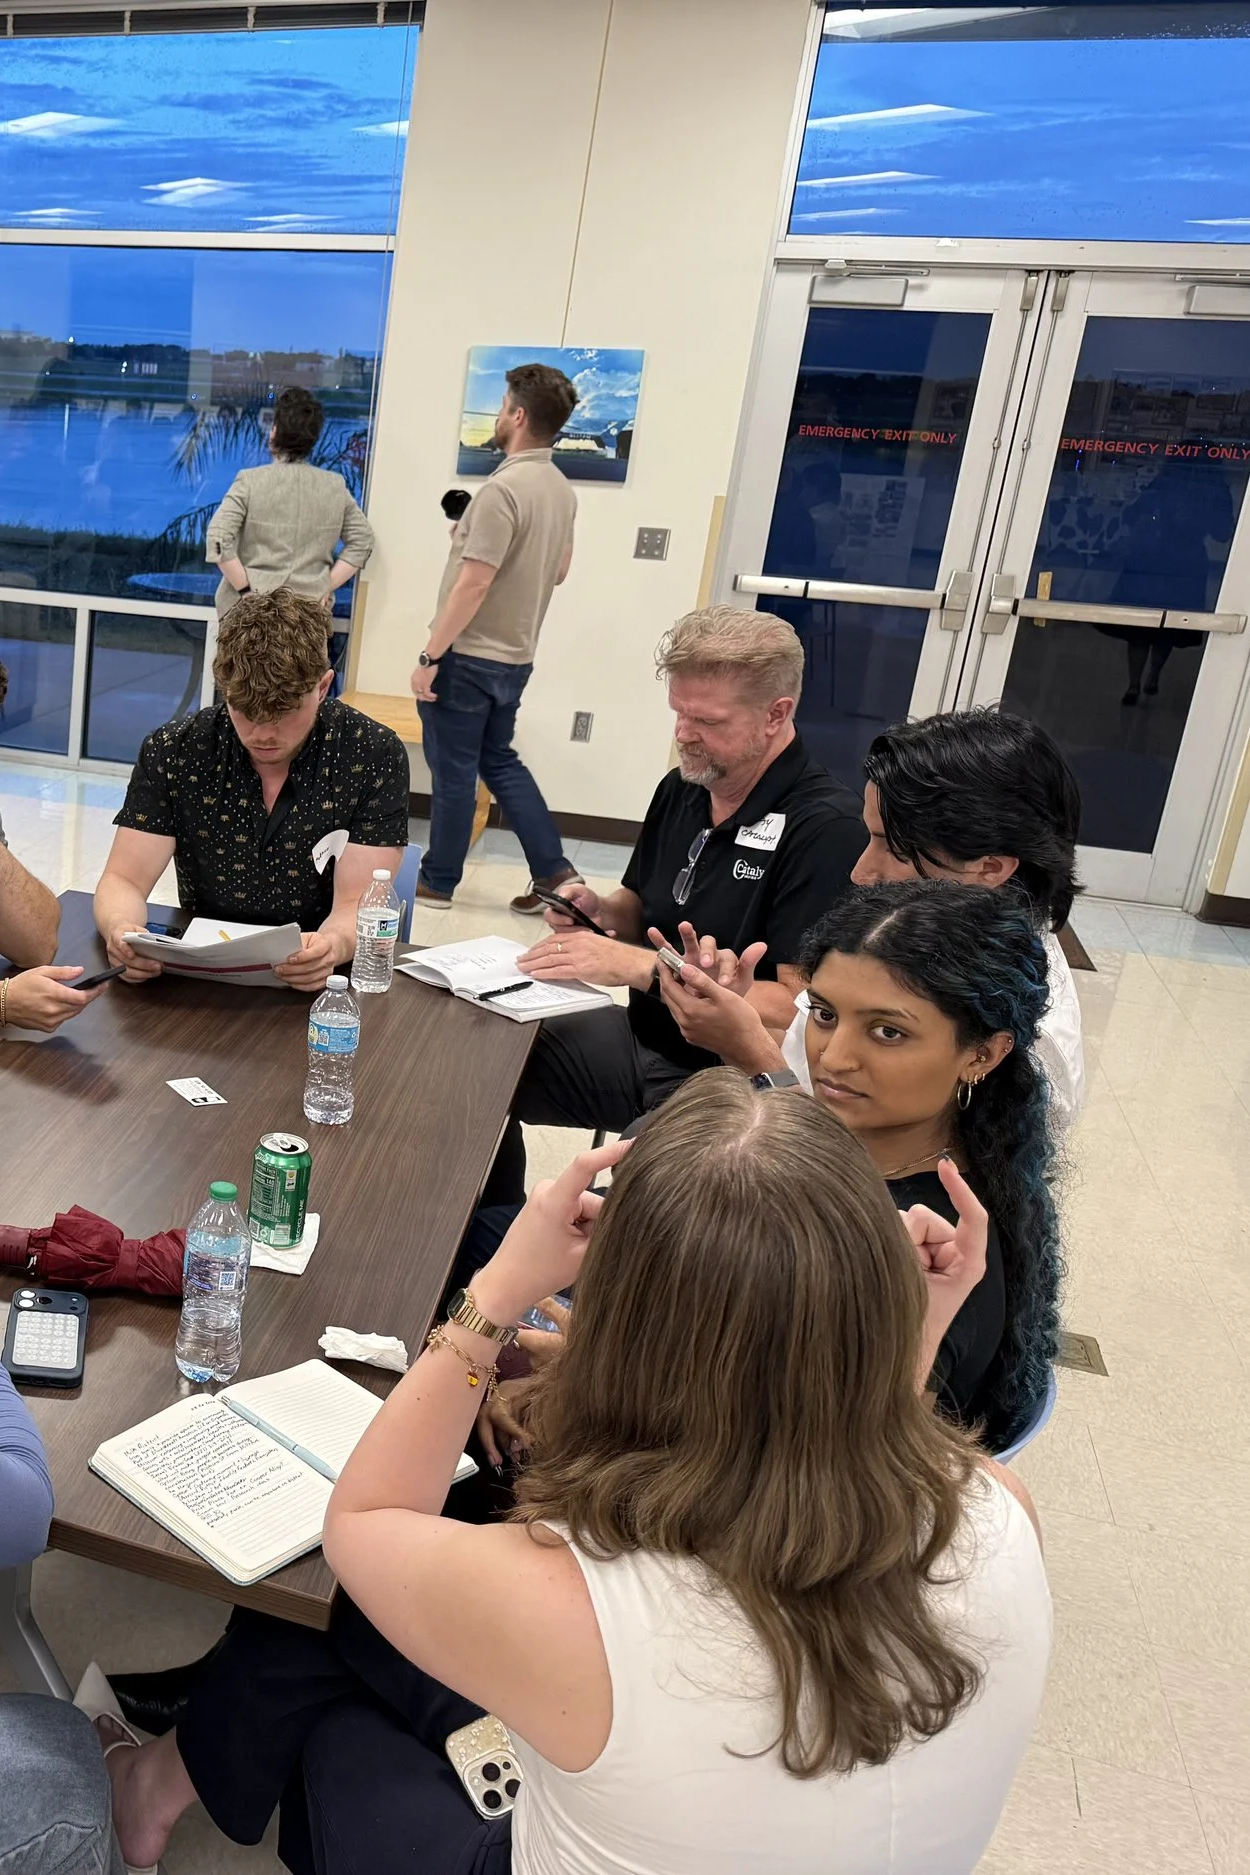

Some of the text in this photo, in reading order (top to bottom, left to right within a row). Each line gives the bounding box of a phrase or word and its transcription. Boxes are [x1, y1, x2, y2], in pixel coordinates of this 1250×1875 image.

[798, 425, 958, 444] EMERGENCY EXIT ONLY
[1060, 438, 1250, 460] EMERGENCY EXIT ONLY
[734, 860, 765, 880] Cataly
